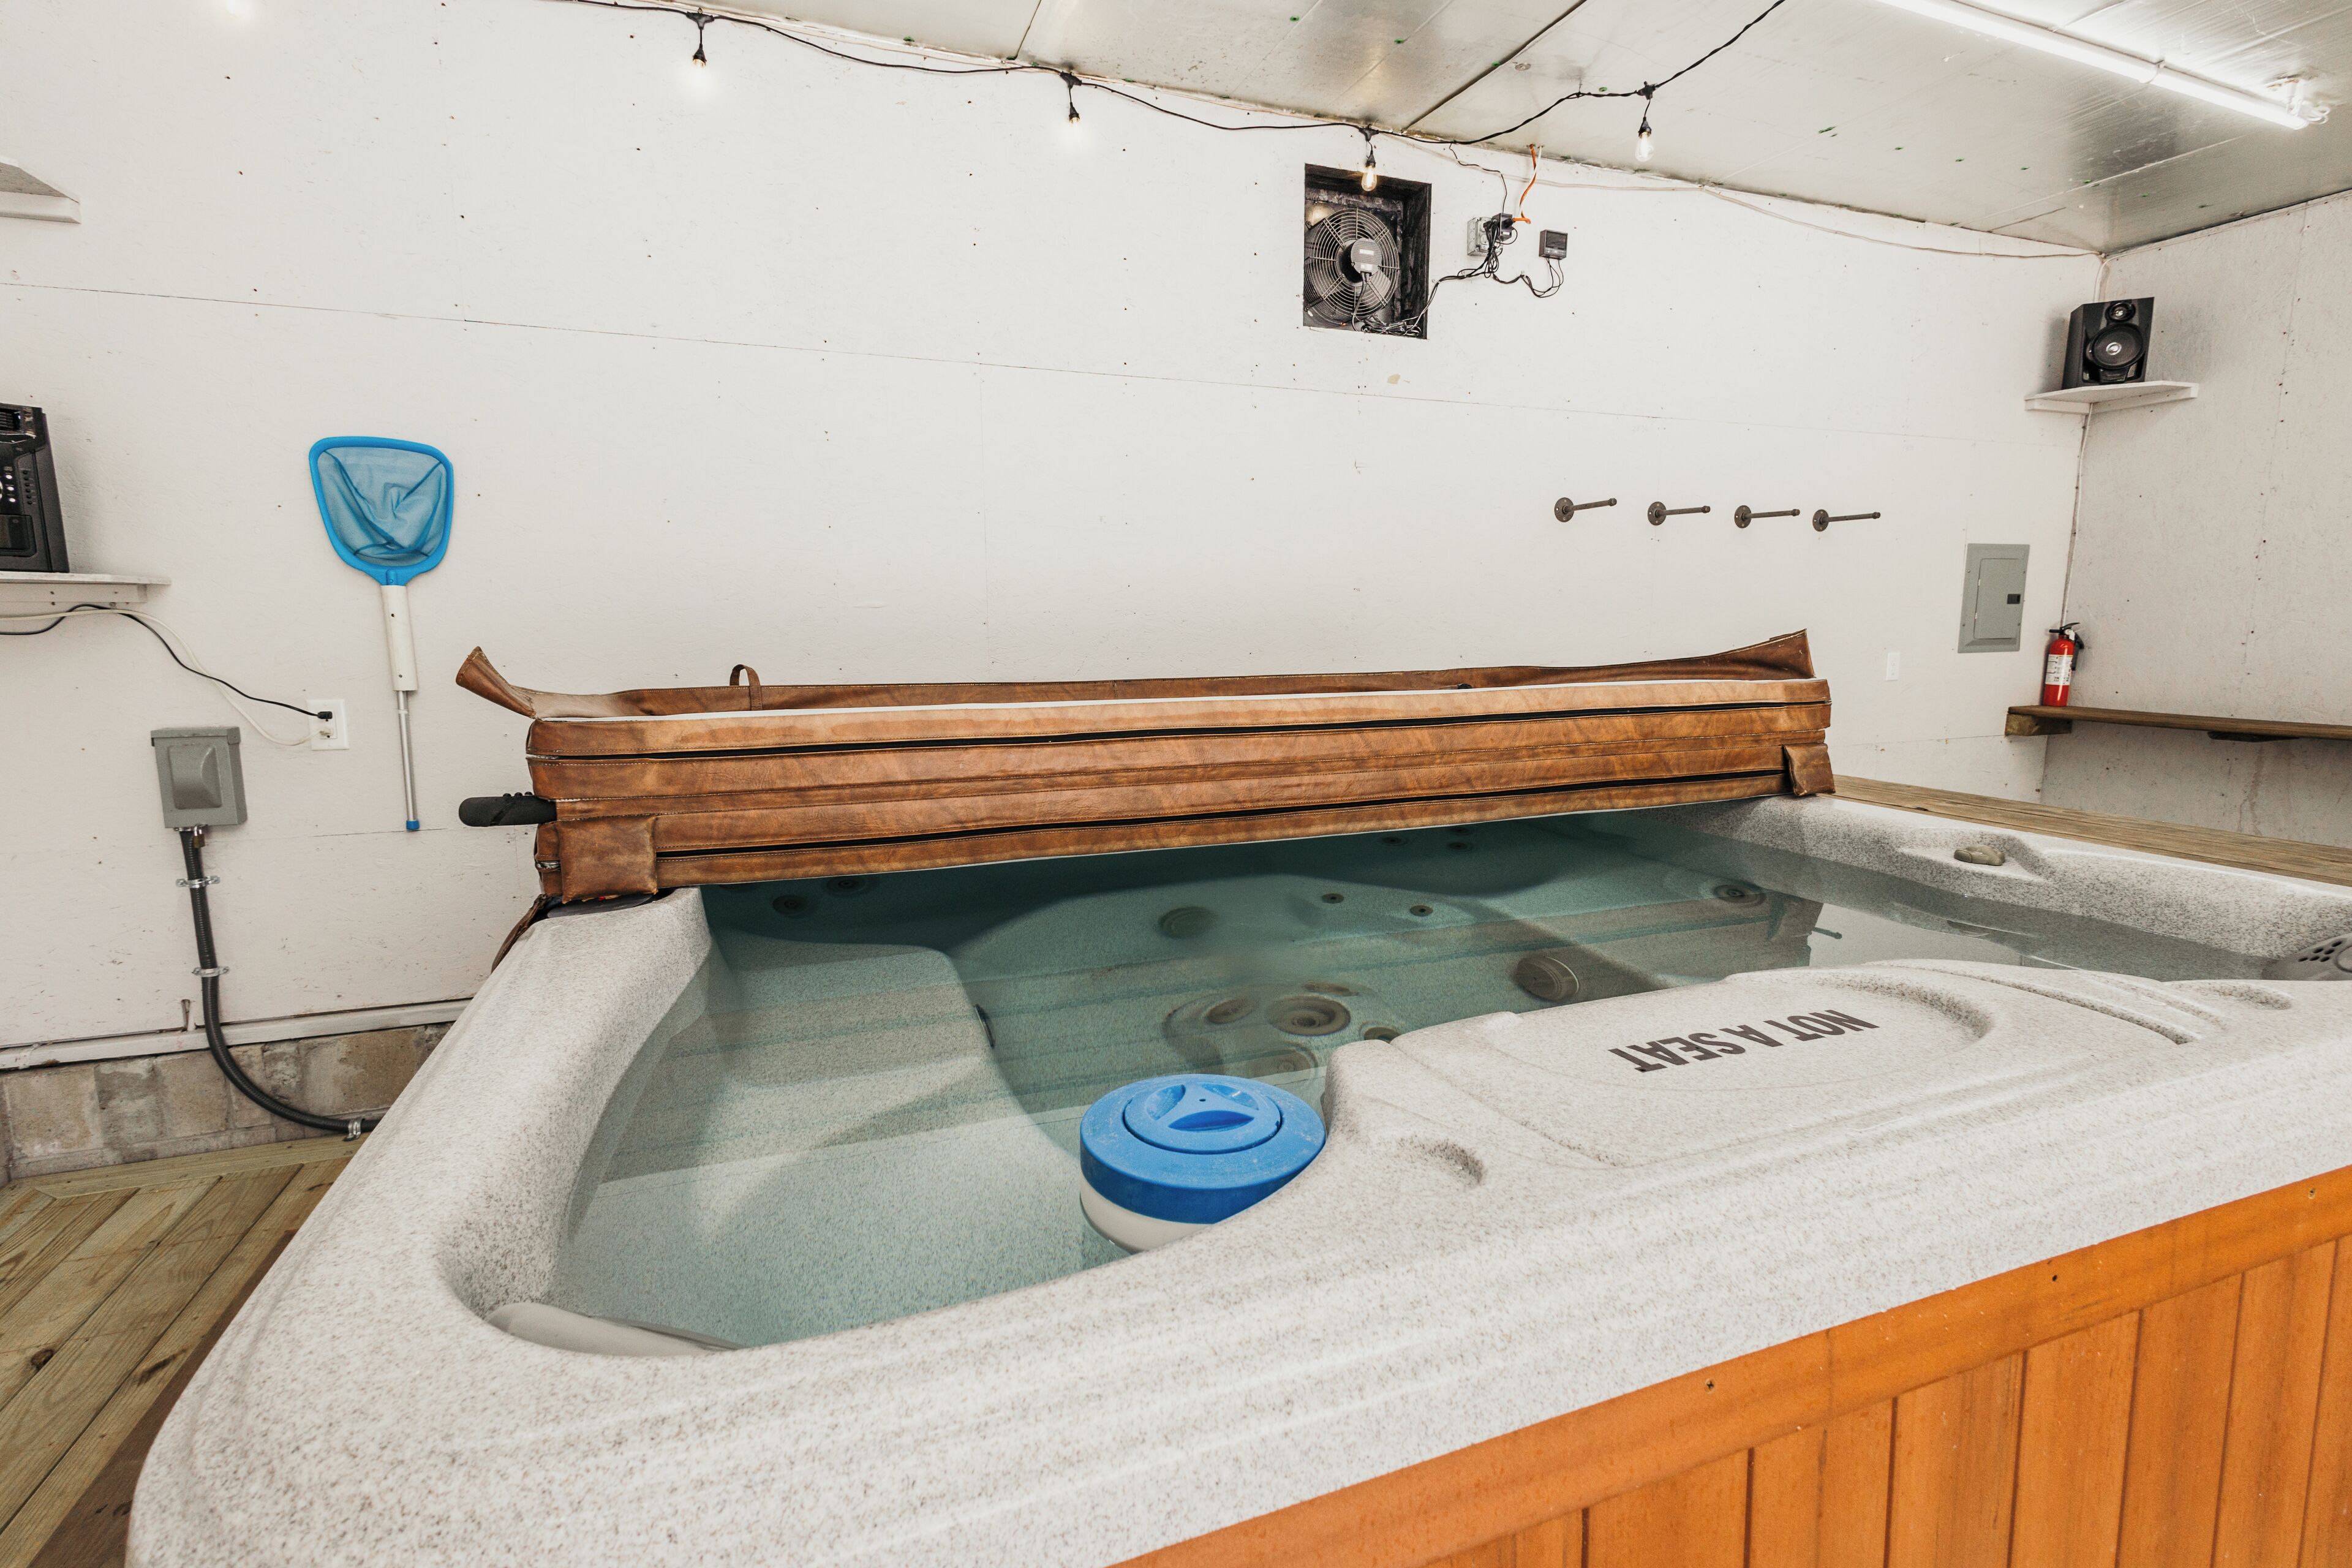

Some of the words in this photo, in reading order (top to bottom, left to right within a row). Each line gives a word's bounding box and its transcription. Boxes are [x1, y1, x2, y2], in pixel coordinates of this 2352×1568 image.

[1720, 1025, 1784, 1047] A
[1764, 1009, 1879, 1041] NOT
[1608, 1033, 1746, 1073] SEAT
